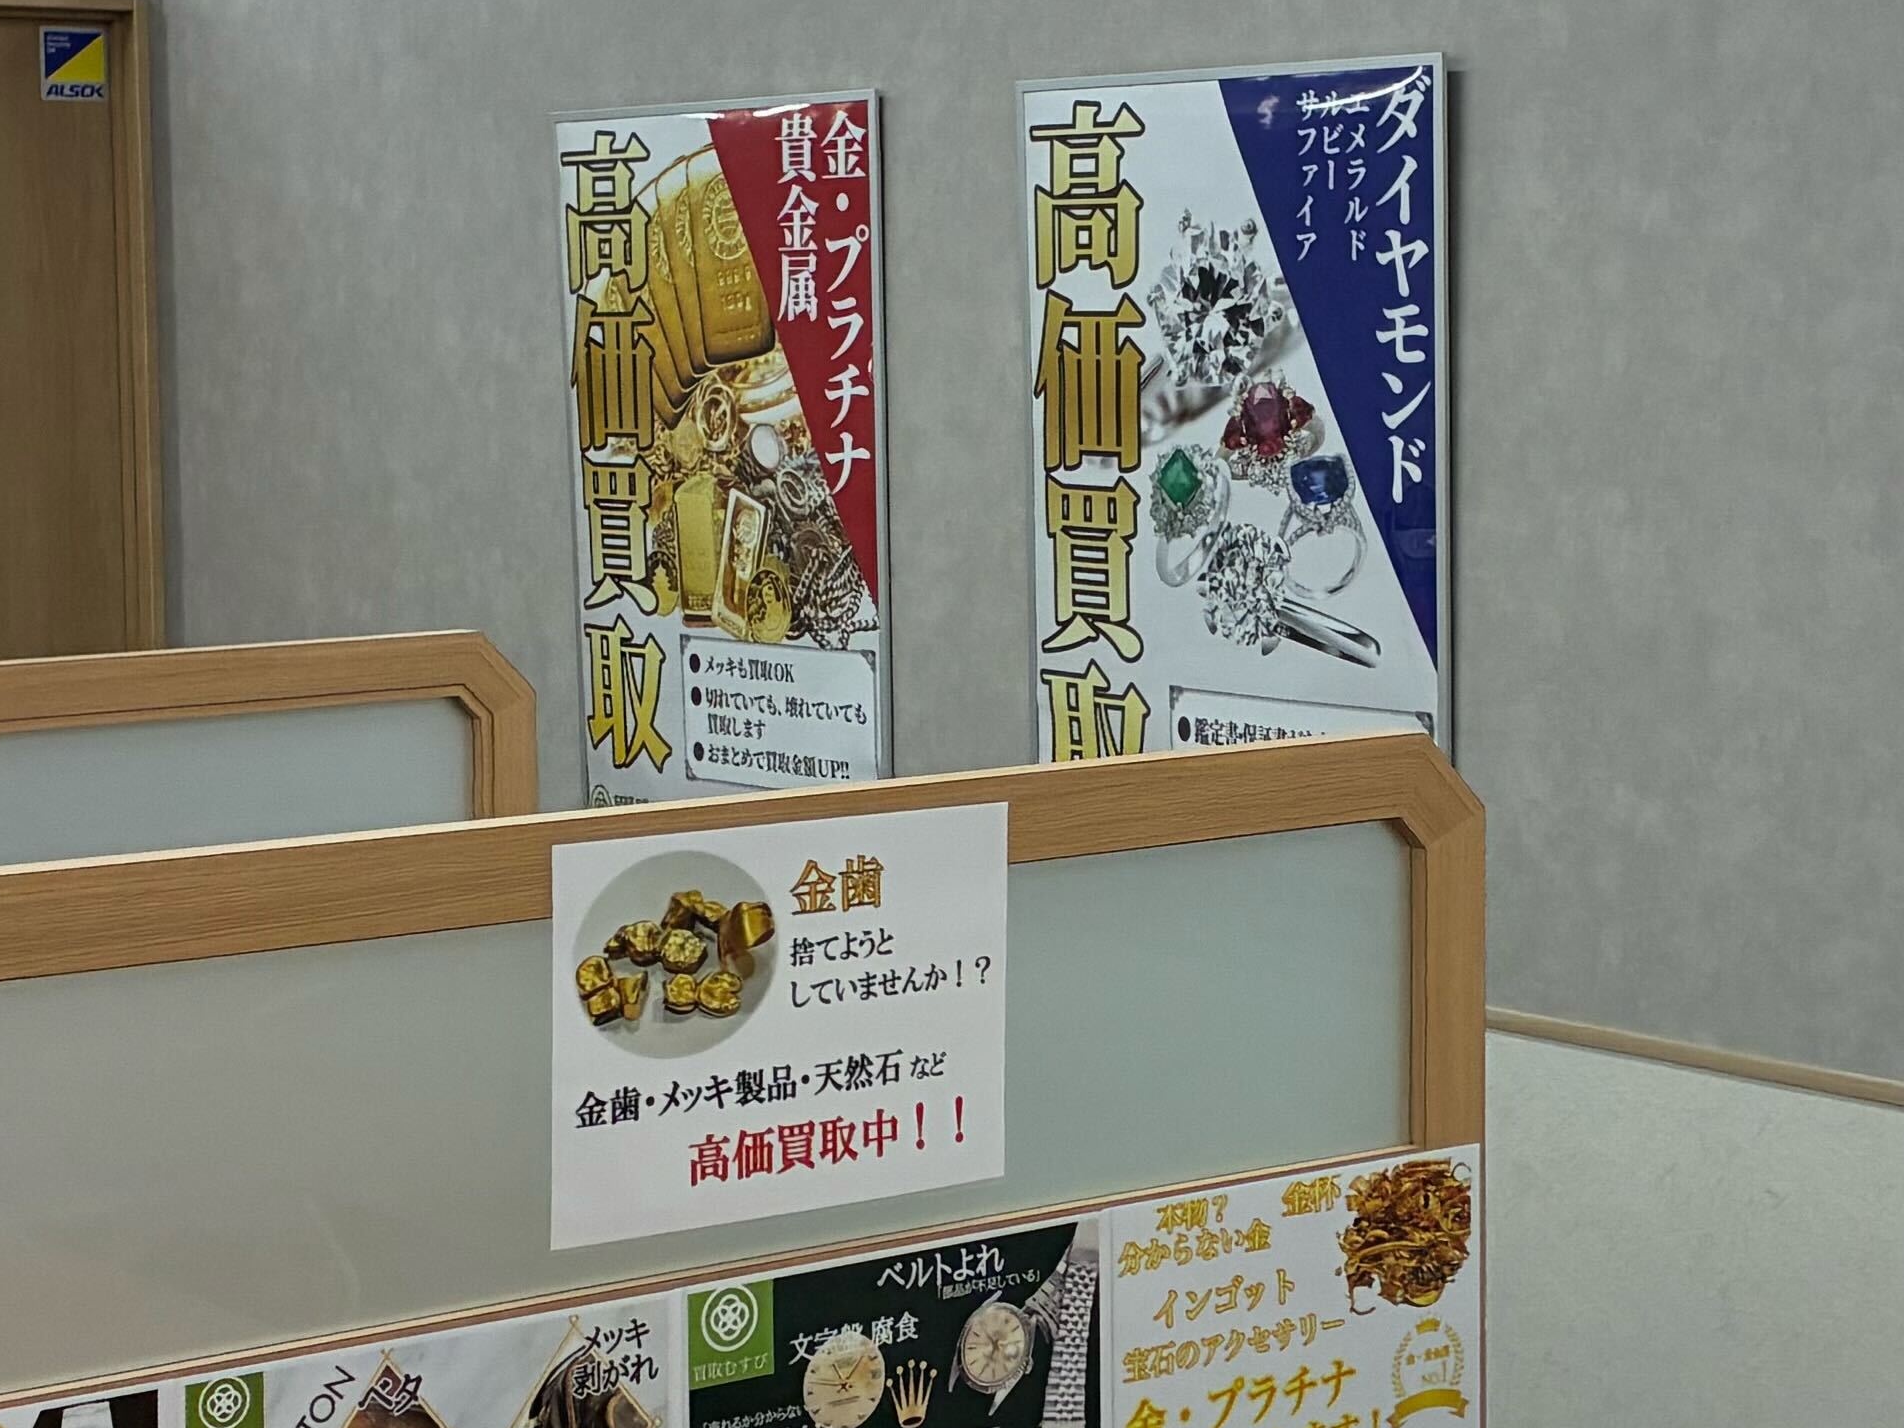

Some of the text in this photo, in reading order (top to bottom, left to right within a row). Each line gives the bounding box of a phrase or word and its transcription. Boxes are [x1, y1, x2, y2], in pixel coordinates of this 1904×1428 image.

[46, 84, 105, 98] ALSOK
[1320, 91, 1345, 190] ルビー
[1295, 89, 1320, 262] サファイア
[1344, 91, 1371, 262] エメラルド
[774, 113, 820, 322] 貴金属
[820, 109, 871, 495] 金・プラチナ
[1375, 69, 1432, 504] ダイヤモンド
[559, 129, 673, 774] 高価買取
[704, 655, 795, 683] メッキも買取OK
[707, 713, 766, 740] 買取します
[789, 854, 884, 916] 金歯
[789, 927, 895, 968] 捨てようと
[877, 1244, 1005, 1289] ベルトよれ
[1117, 1217, 1272, 1278] 分からない金
[1152, 1268, 1296, 1330] インゴット
[581, 1319, 650, 1355] メッキ
[1122, 1313, 1346, 1384] 宝石のアクセサリー
[573, 1354, 659, 1397] 剥がれ
